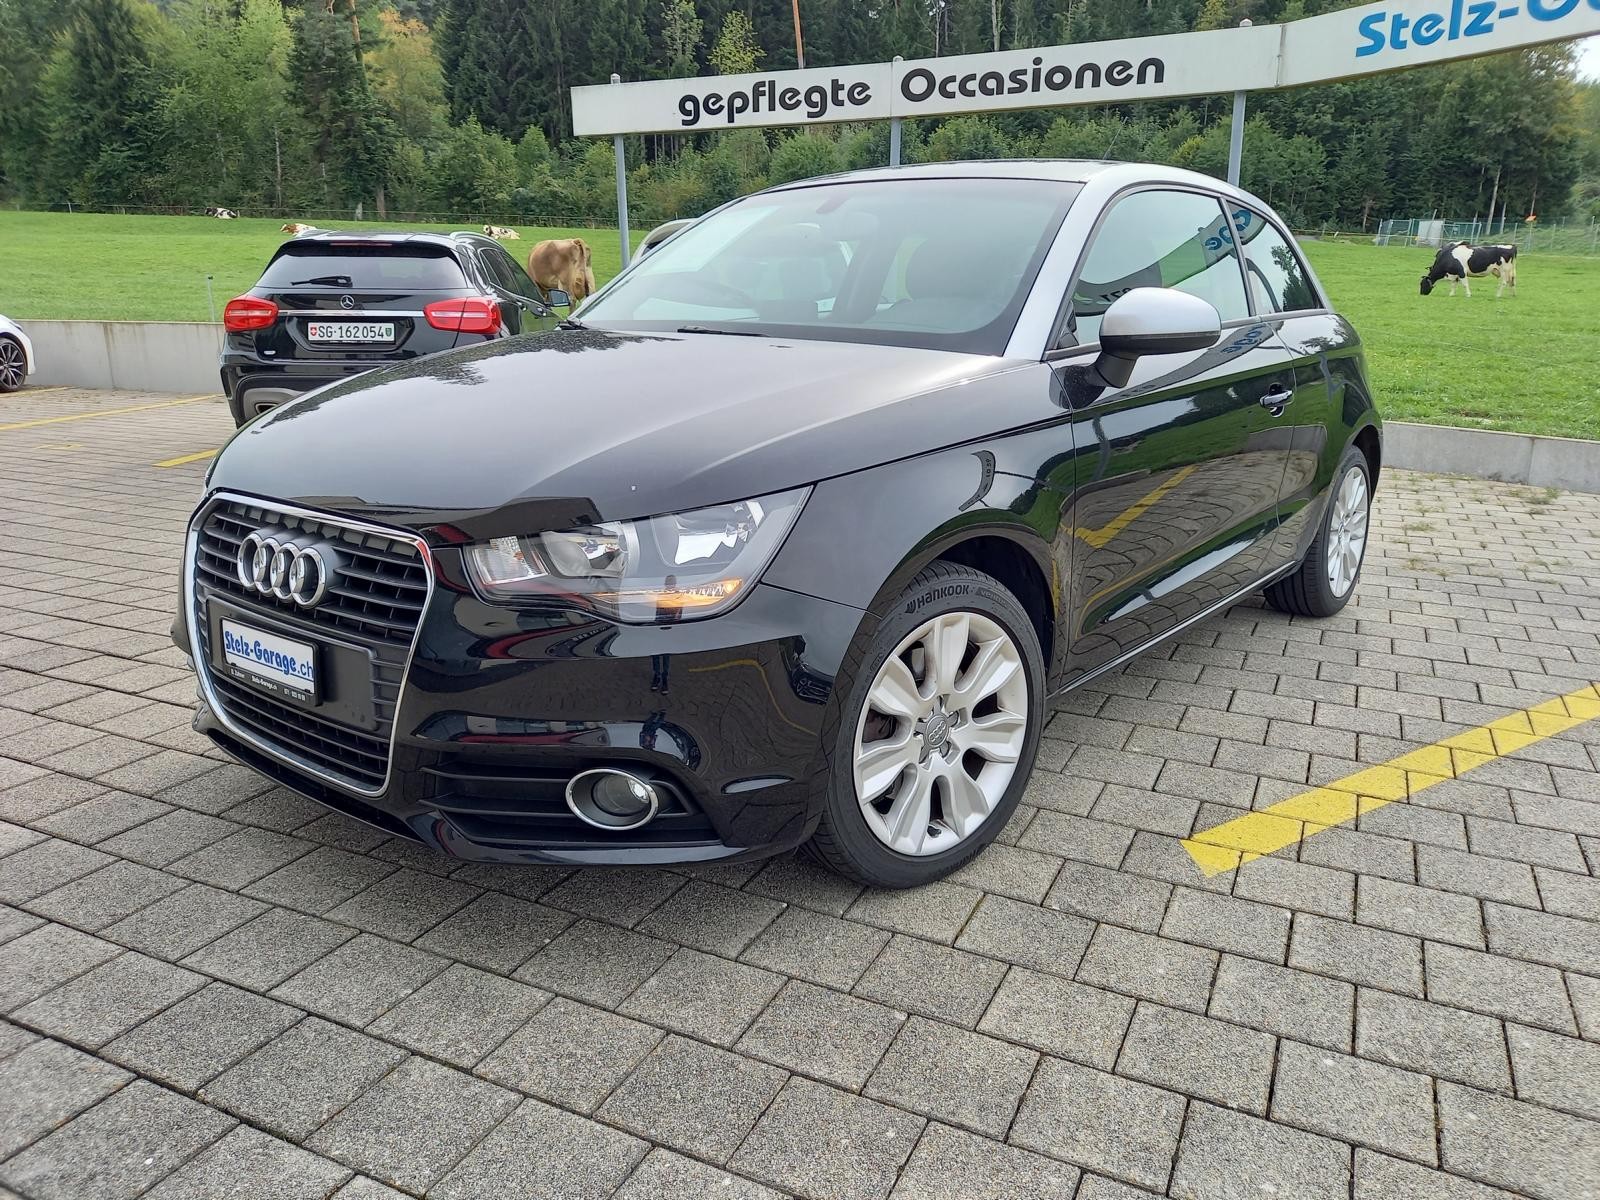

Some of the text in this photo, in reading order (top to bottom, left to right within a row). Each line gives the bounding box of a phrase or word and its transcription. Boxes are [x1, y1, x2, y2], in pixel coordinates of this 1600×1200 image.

[1355, 0, 1600, 58] Stelz-
[678, 56, 1166, 126] gepflegte Occasionen
[224, 630, 314, 678] Stelz-Garage.ch
